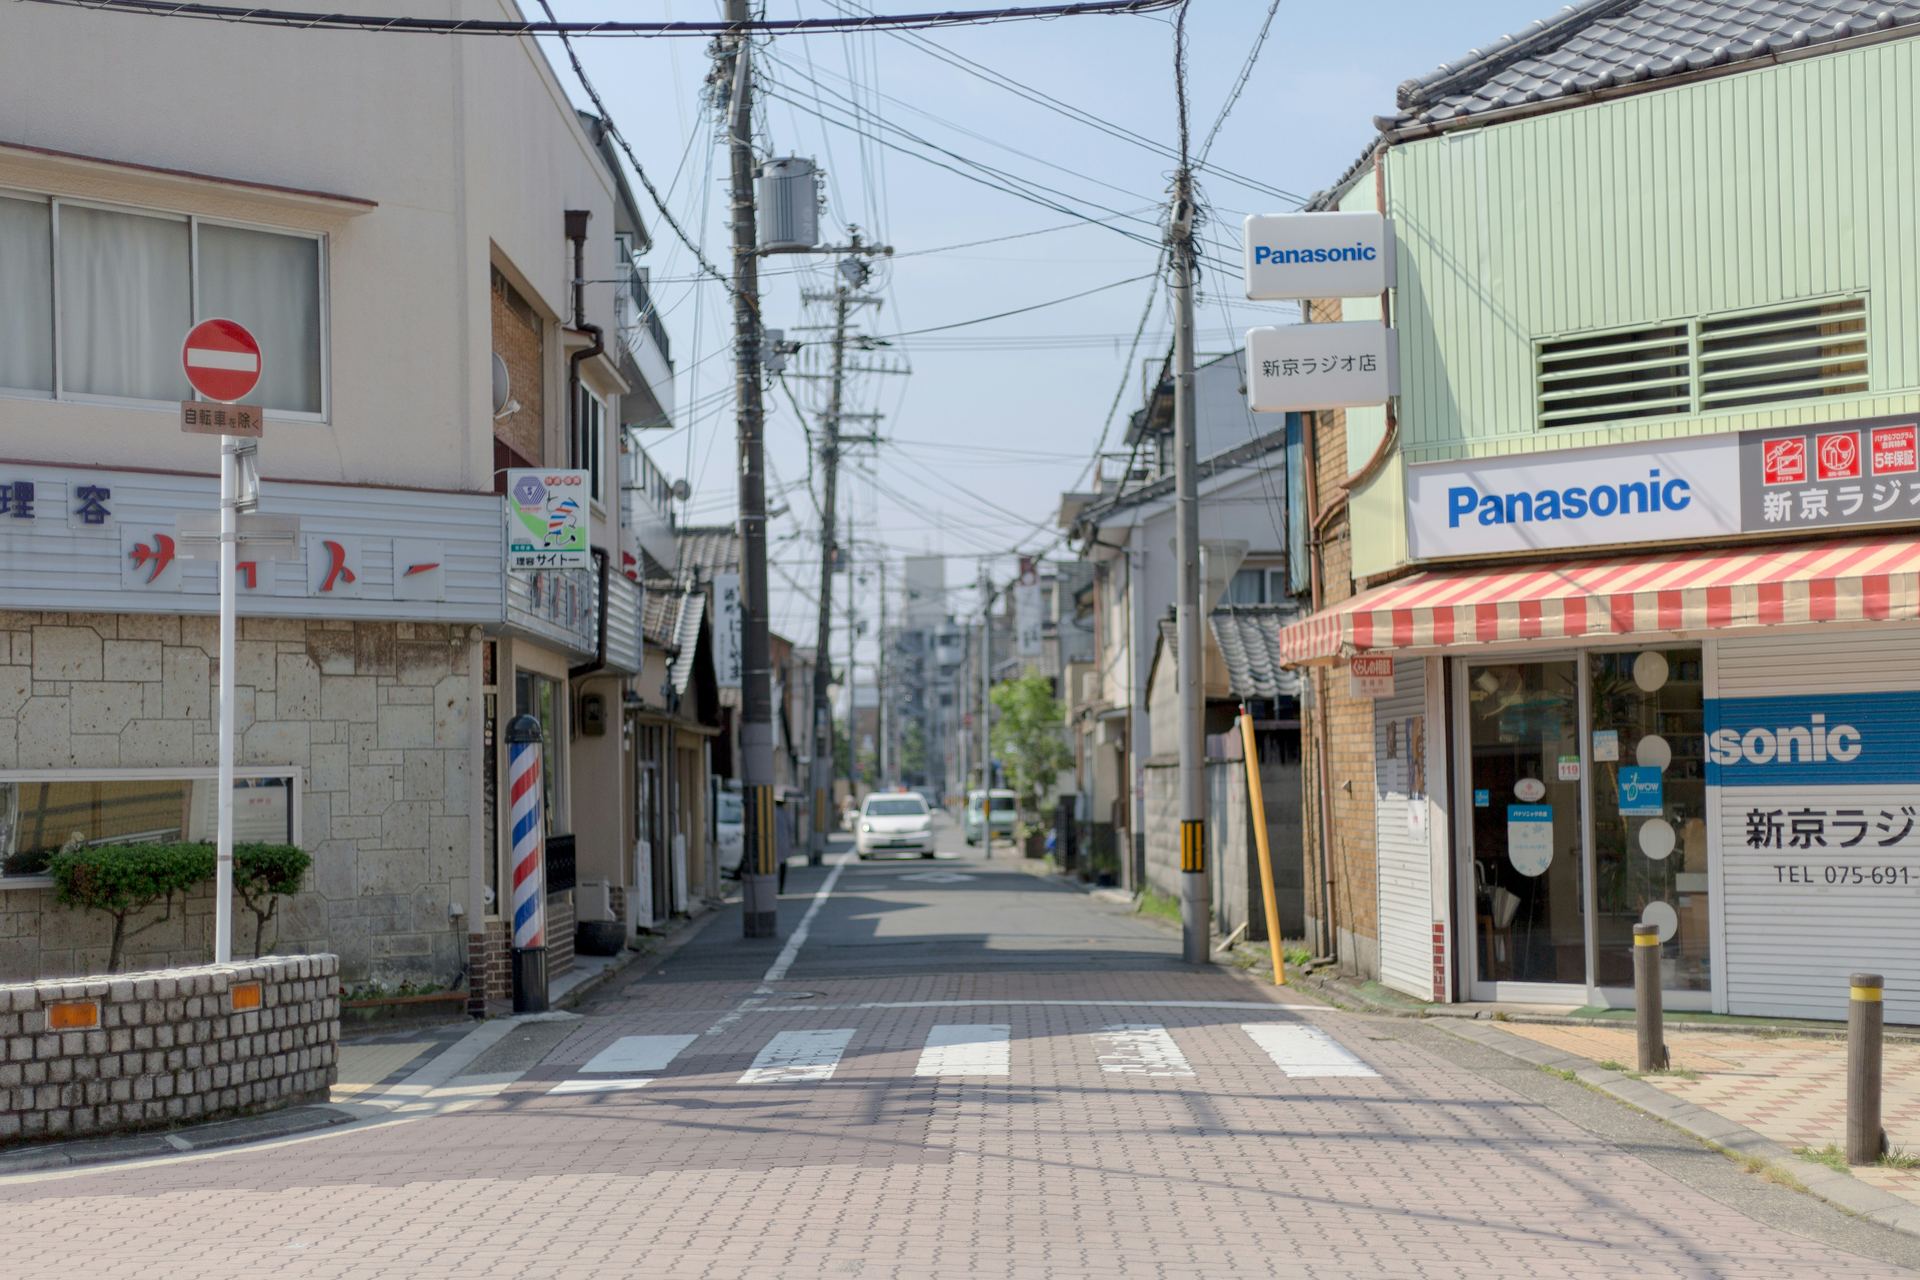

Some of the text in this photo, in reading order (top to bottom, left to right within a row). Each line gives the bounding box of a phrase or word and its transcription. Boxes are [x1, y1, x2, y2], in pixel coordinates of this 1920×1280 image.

[1254, 241, 1377, 265] Panasonic
[1261, 353, 1377, 378] 新京ラジオ店
[184, 408, 260, 430] 自転車を除く
[1874, 449, 1914, 469] 5年保証
[1447, 468, 1692, 529] Panasonic
[1560, 764, 1579, 775] 119
[1746, 806, 1917, 850] 新京ラジ
[1773, 865, 1919, 885] TEL 075-691-
